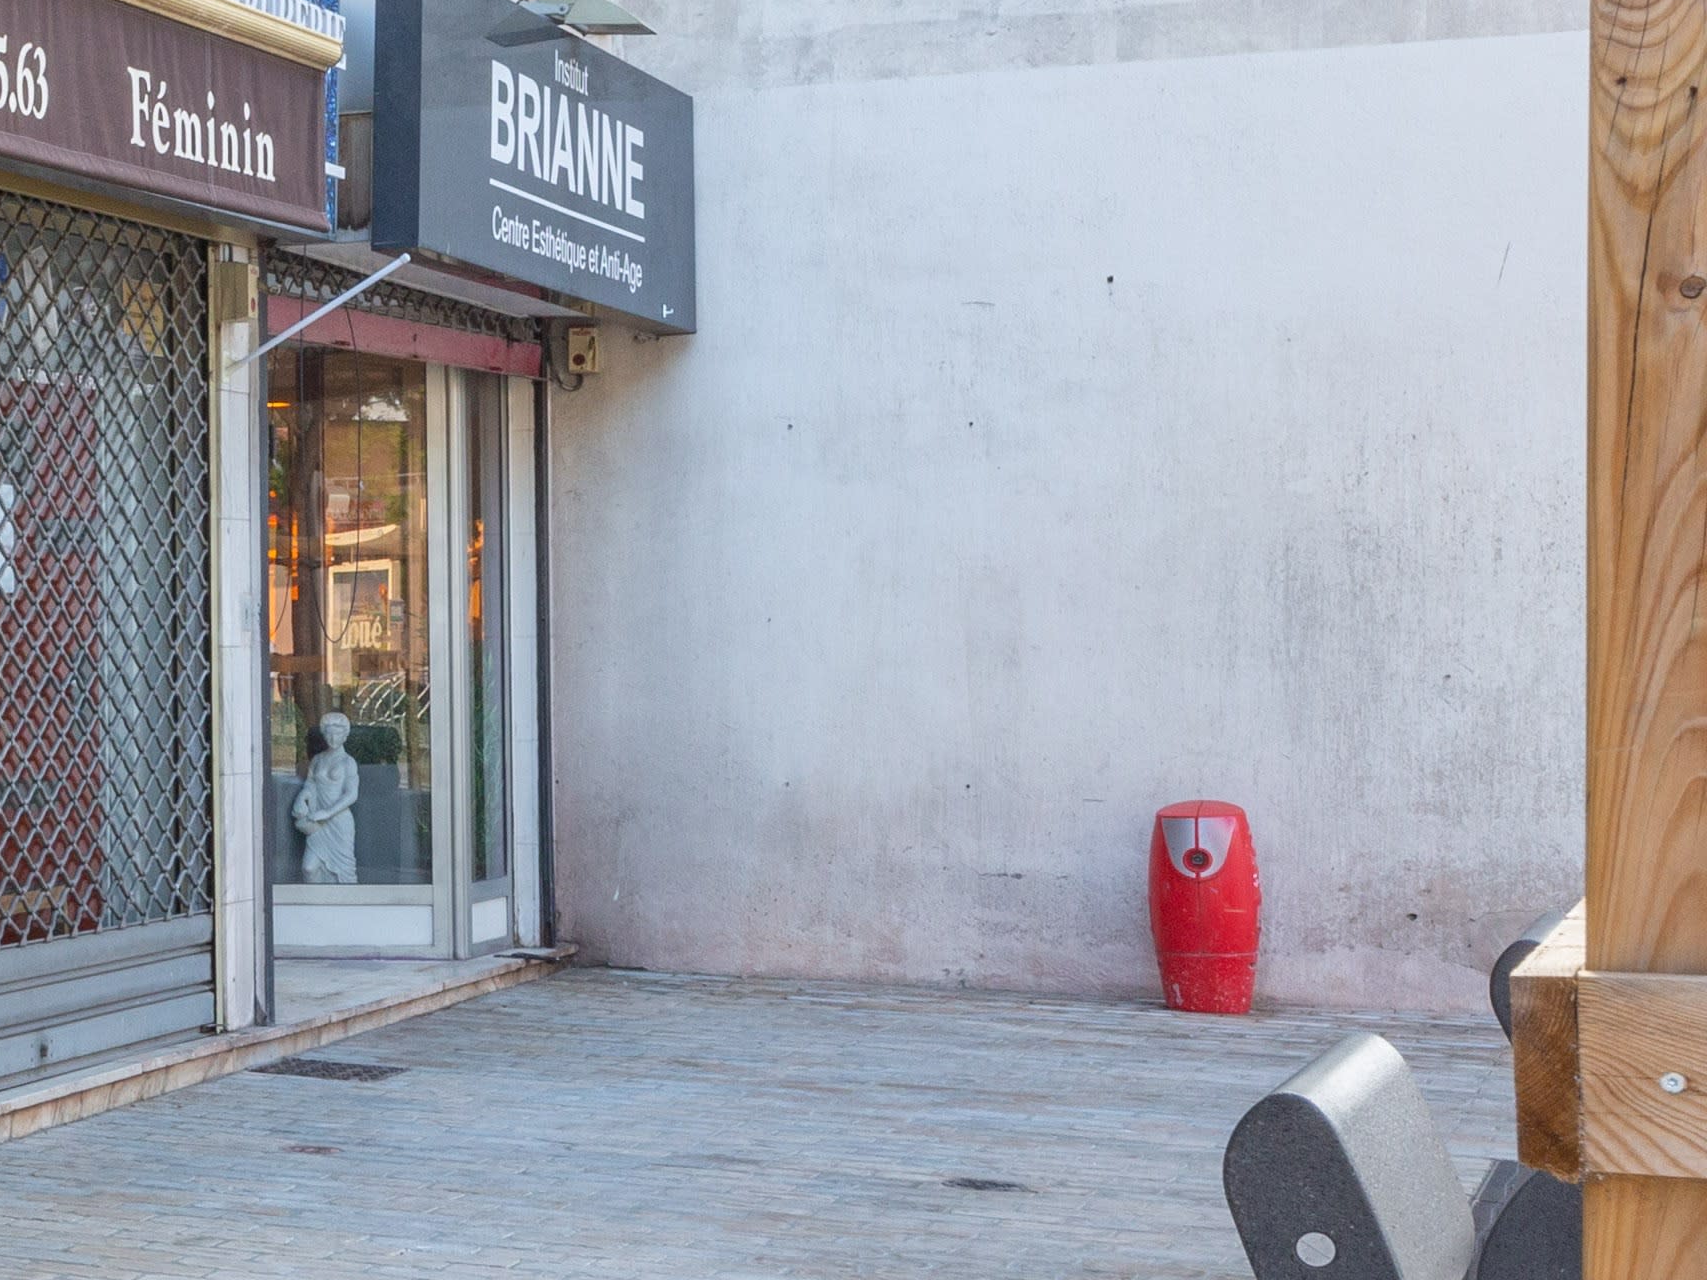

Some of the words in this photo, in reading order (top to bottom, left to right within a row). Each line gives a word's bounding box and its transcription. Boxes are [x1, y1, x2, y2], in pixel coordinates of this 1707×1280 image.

[554, 48, 590, 97] Institut
[126, 66, 276, 183] Féminin
[489, 58, 646, 220] BRIANNE
[491, 204, 531, 251] Centre
[531, 219, 587, 274] Esthétique
[588, 249, 600, 274] et
[599, 244, 644, 294] Anti-Age
